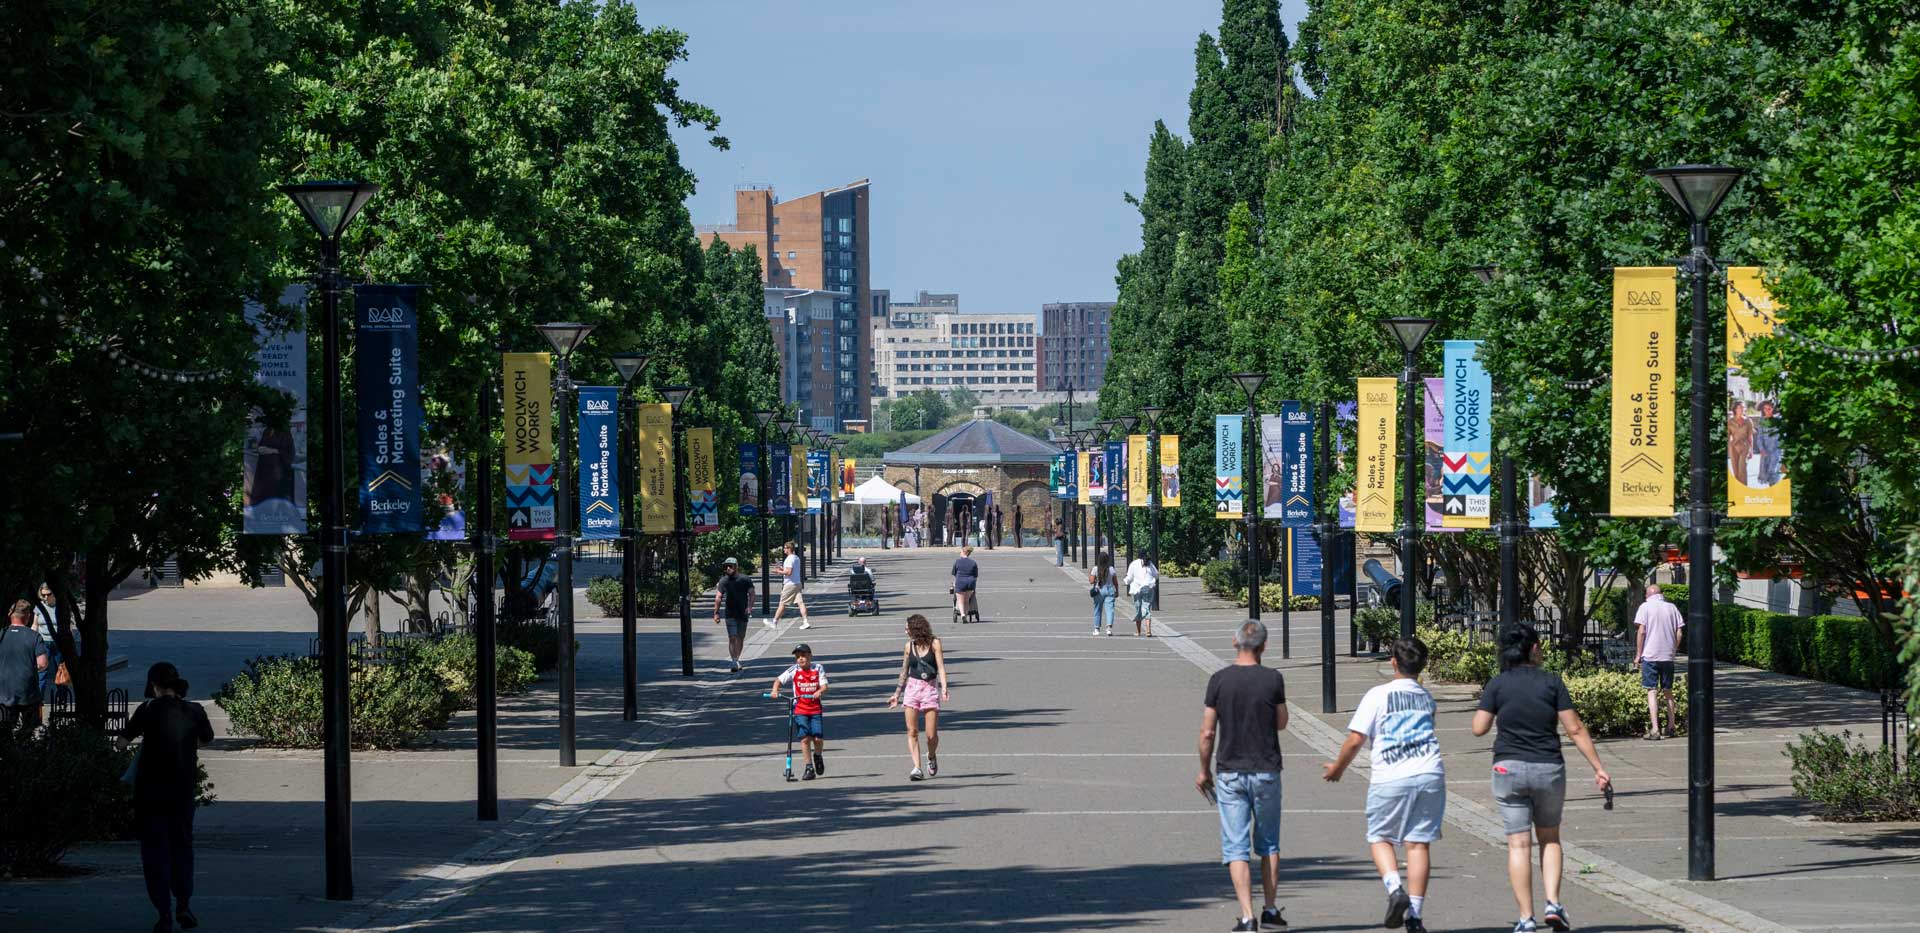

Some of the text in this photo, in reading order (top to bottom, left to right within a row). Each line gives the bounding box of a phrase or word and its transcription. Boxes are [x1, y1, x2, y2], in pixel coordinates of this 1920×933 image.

[1646, 331, 1660, 368] Suite
[389, 348, 405, 464] Marketing Suite
[514, 370, 527, 454] WOOLWICH
[528, 400, 540, 452] WORKS
[1454, 358, 1467, 442] WOOLWICH
[1468, 389, 1480, 442] WORKS
[1630, 392, 1642, 446] Sales &
[1646, 372, 1662, 446] Marketing
[374, 410, 388, 464] Sales &
[600, 424, 610, 497] Marketing Suite
[1222, 424, 1230, 472] WOOLWICH
[1298, 432, 1308, 492] Marketing Suite
[1377, 418, 1388, 489] Marketing Suite
[590, 472, 600, 498] Sales
[1290, 472, 1298, 492] Sales
[1368, 466, 1376, 489] Sales
[1622, 482, 1662, 494] Berkeley
[370, 500, 411, 513] Berkeley
